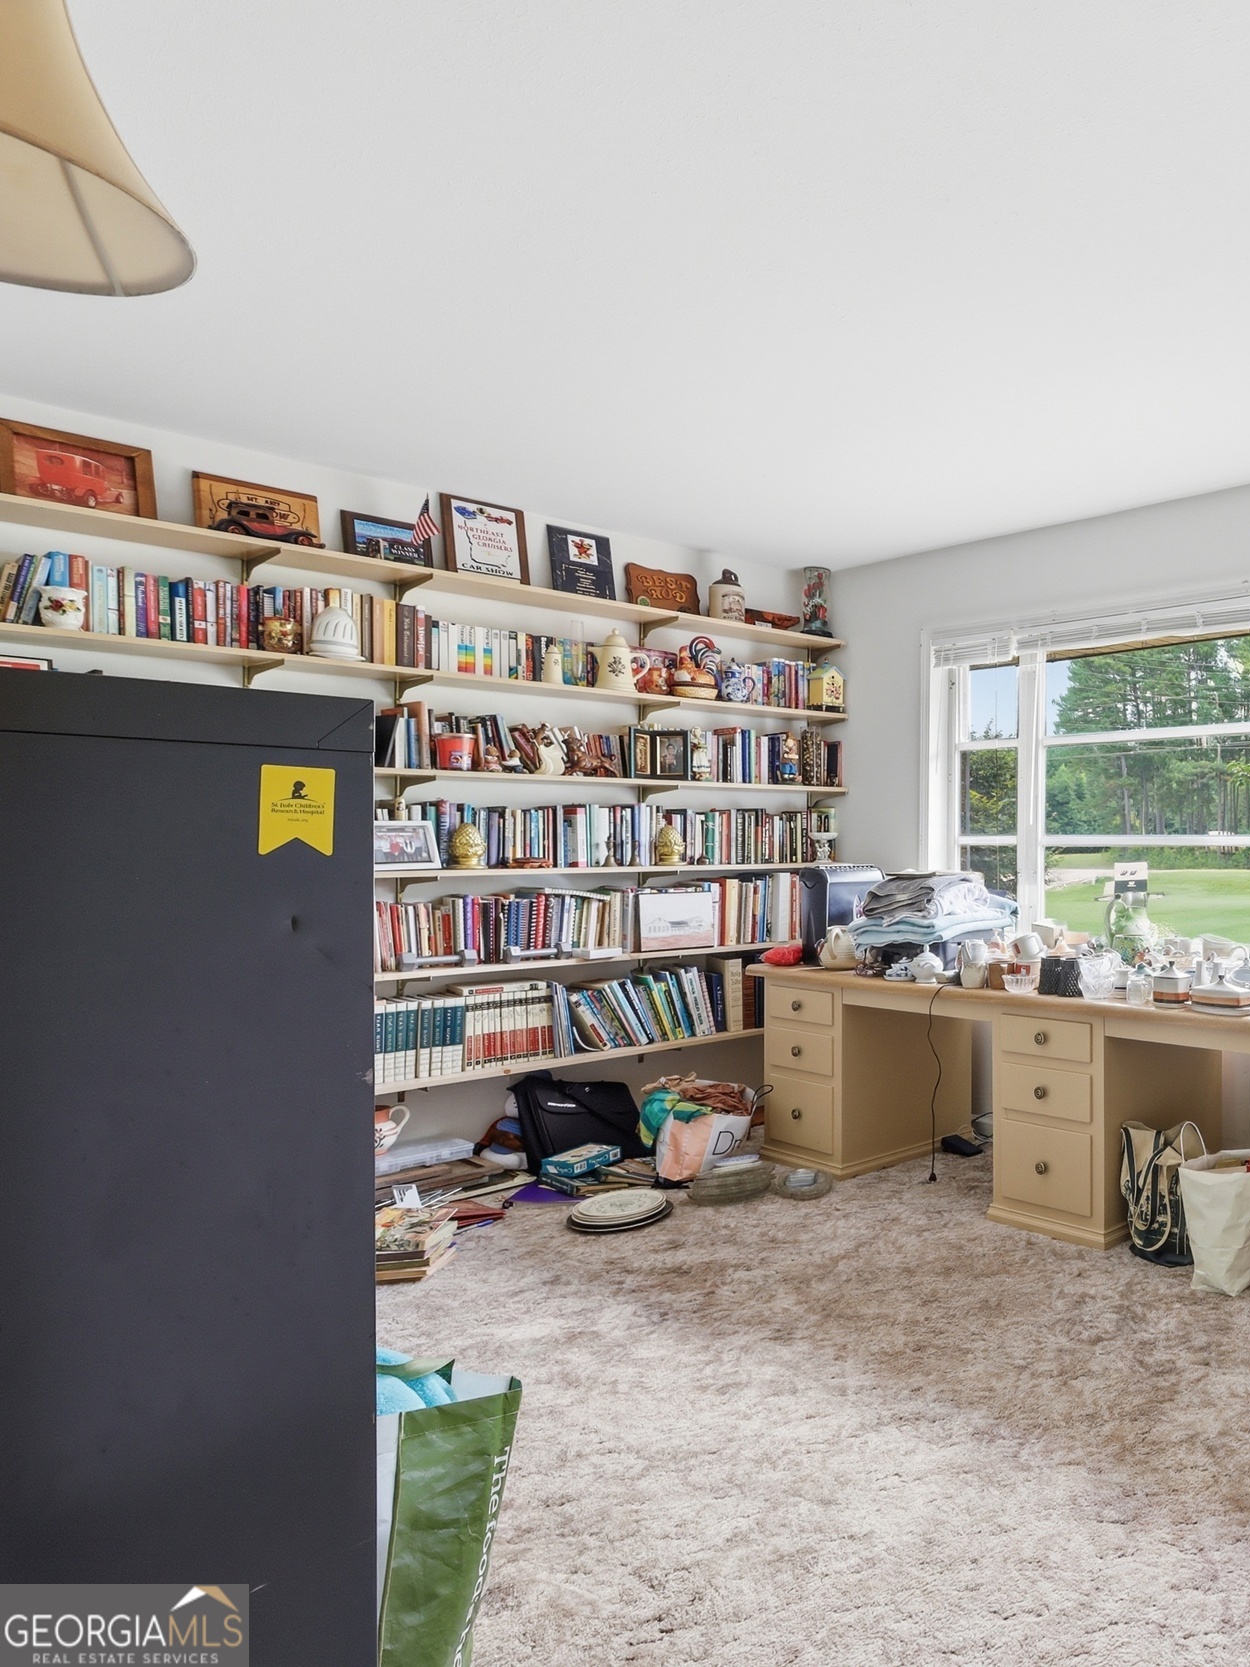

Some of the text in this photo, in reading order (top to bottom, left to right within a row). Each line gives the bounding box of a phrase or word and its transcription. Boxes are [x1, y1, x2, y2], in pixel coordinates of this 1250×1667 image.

[457, 524, 504, 538] NORTHEAST
[472, 534, 507, 545] GEORGIA
[477, 541, 513, 553] CRUISERS
[461, 562, 514, 577] CAR SHOW
[637, 574, 691, 591] BEST
[489, 1445, 510, 1515] The
